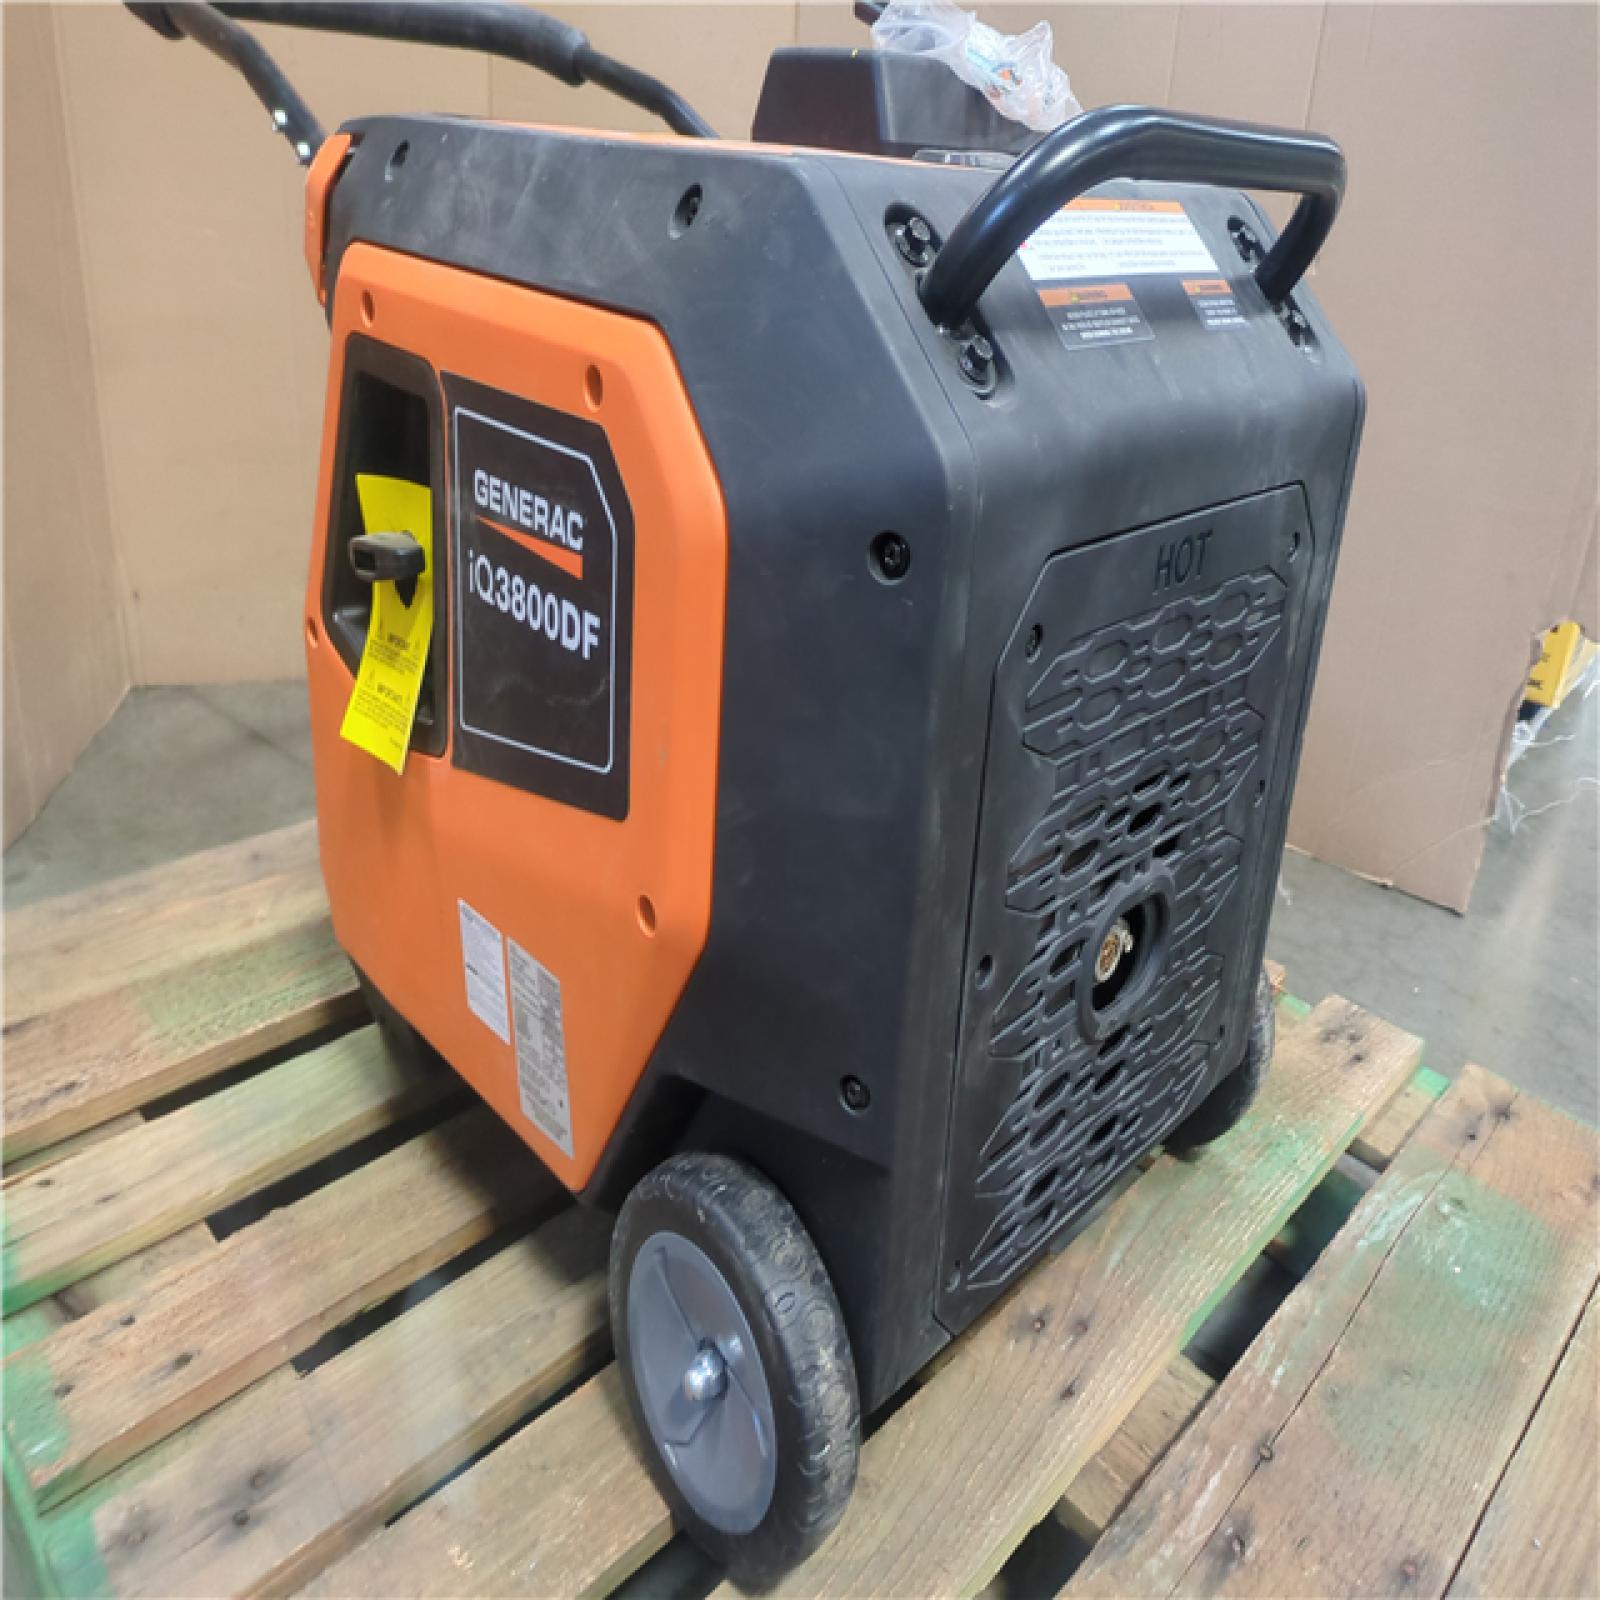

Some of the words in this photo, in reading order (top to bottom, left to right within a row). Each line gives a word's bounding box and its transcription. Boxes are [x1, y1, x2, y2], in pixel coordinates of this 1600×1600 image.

[474, 467, 584, 551] GENERAC
[1154, 528, 1213, 591] HOT
[468, 546, 601, 660] iQ3800DF
